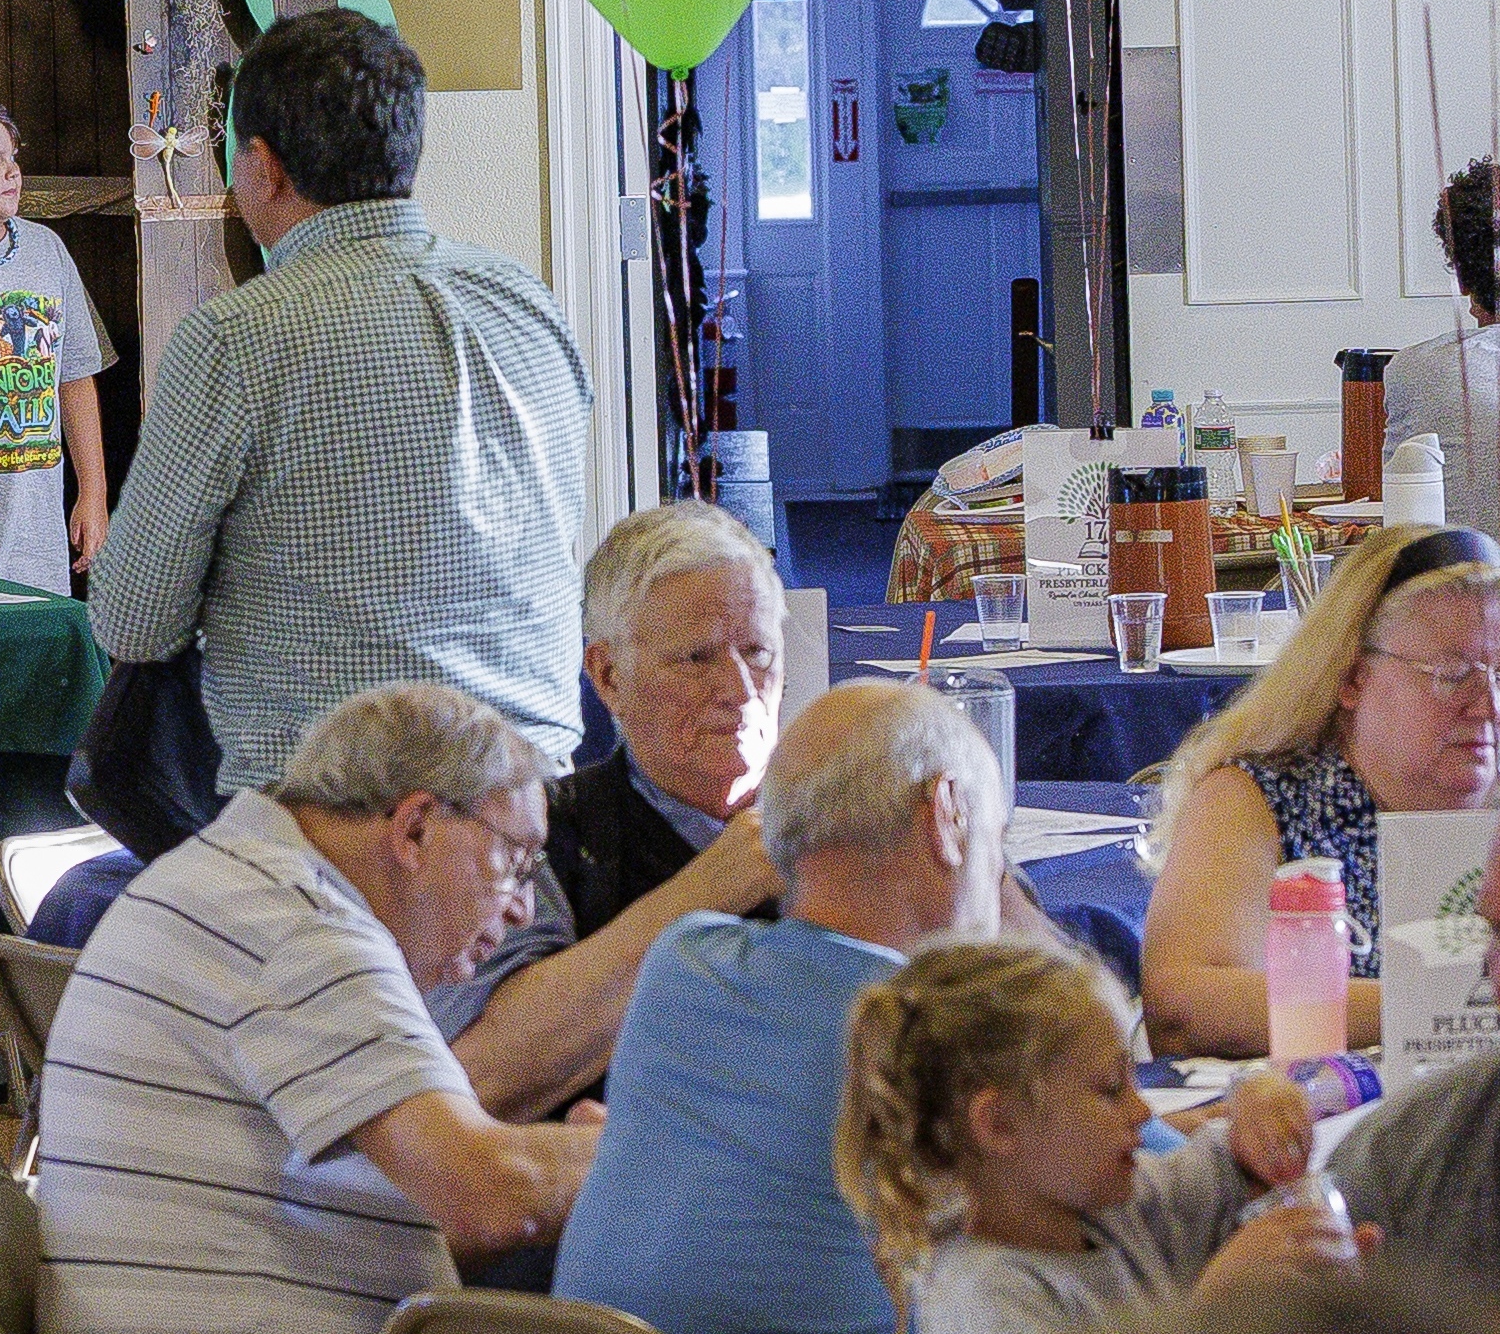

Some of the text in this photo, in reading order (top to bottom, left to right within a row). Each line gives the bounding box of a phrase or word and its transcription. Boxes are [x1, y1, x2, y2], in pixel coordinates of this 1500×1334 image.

[1084, 520, 1107, 541] 17
[1057, 563, 1107, 577] PLUCK
[1039, 578, 1109, 589] PRESBYTERI
